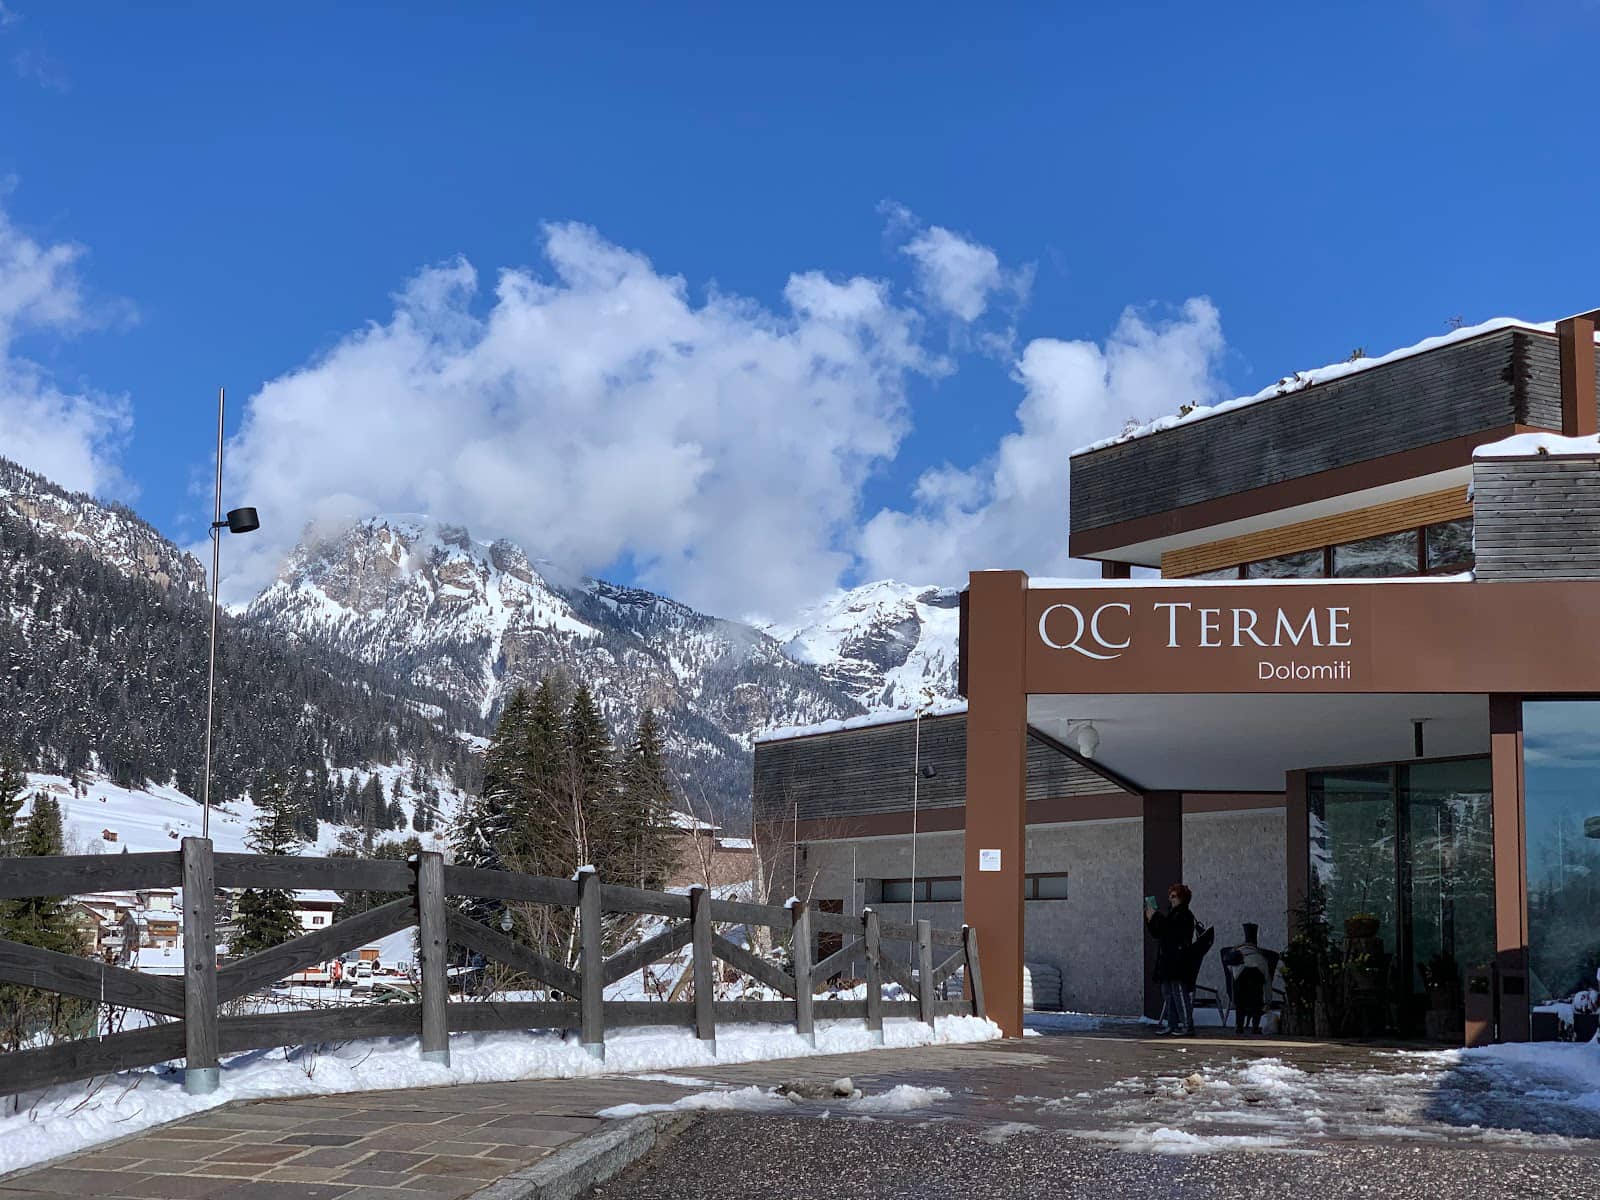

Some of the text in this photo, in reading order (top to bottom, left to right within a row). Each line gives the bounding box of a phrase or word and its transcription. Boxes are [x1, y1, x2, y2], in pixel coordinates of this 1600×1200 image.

[1038, 602, 1352, 660] QC TERME
[1258, 660, 1351, 680] Dolomiti
